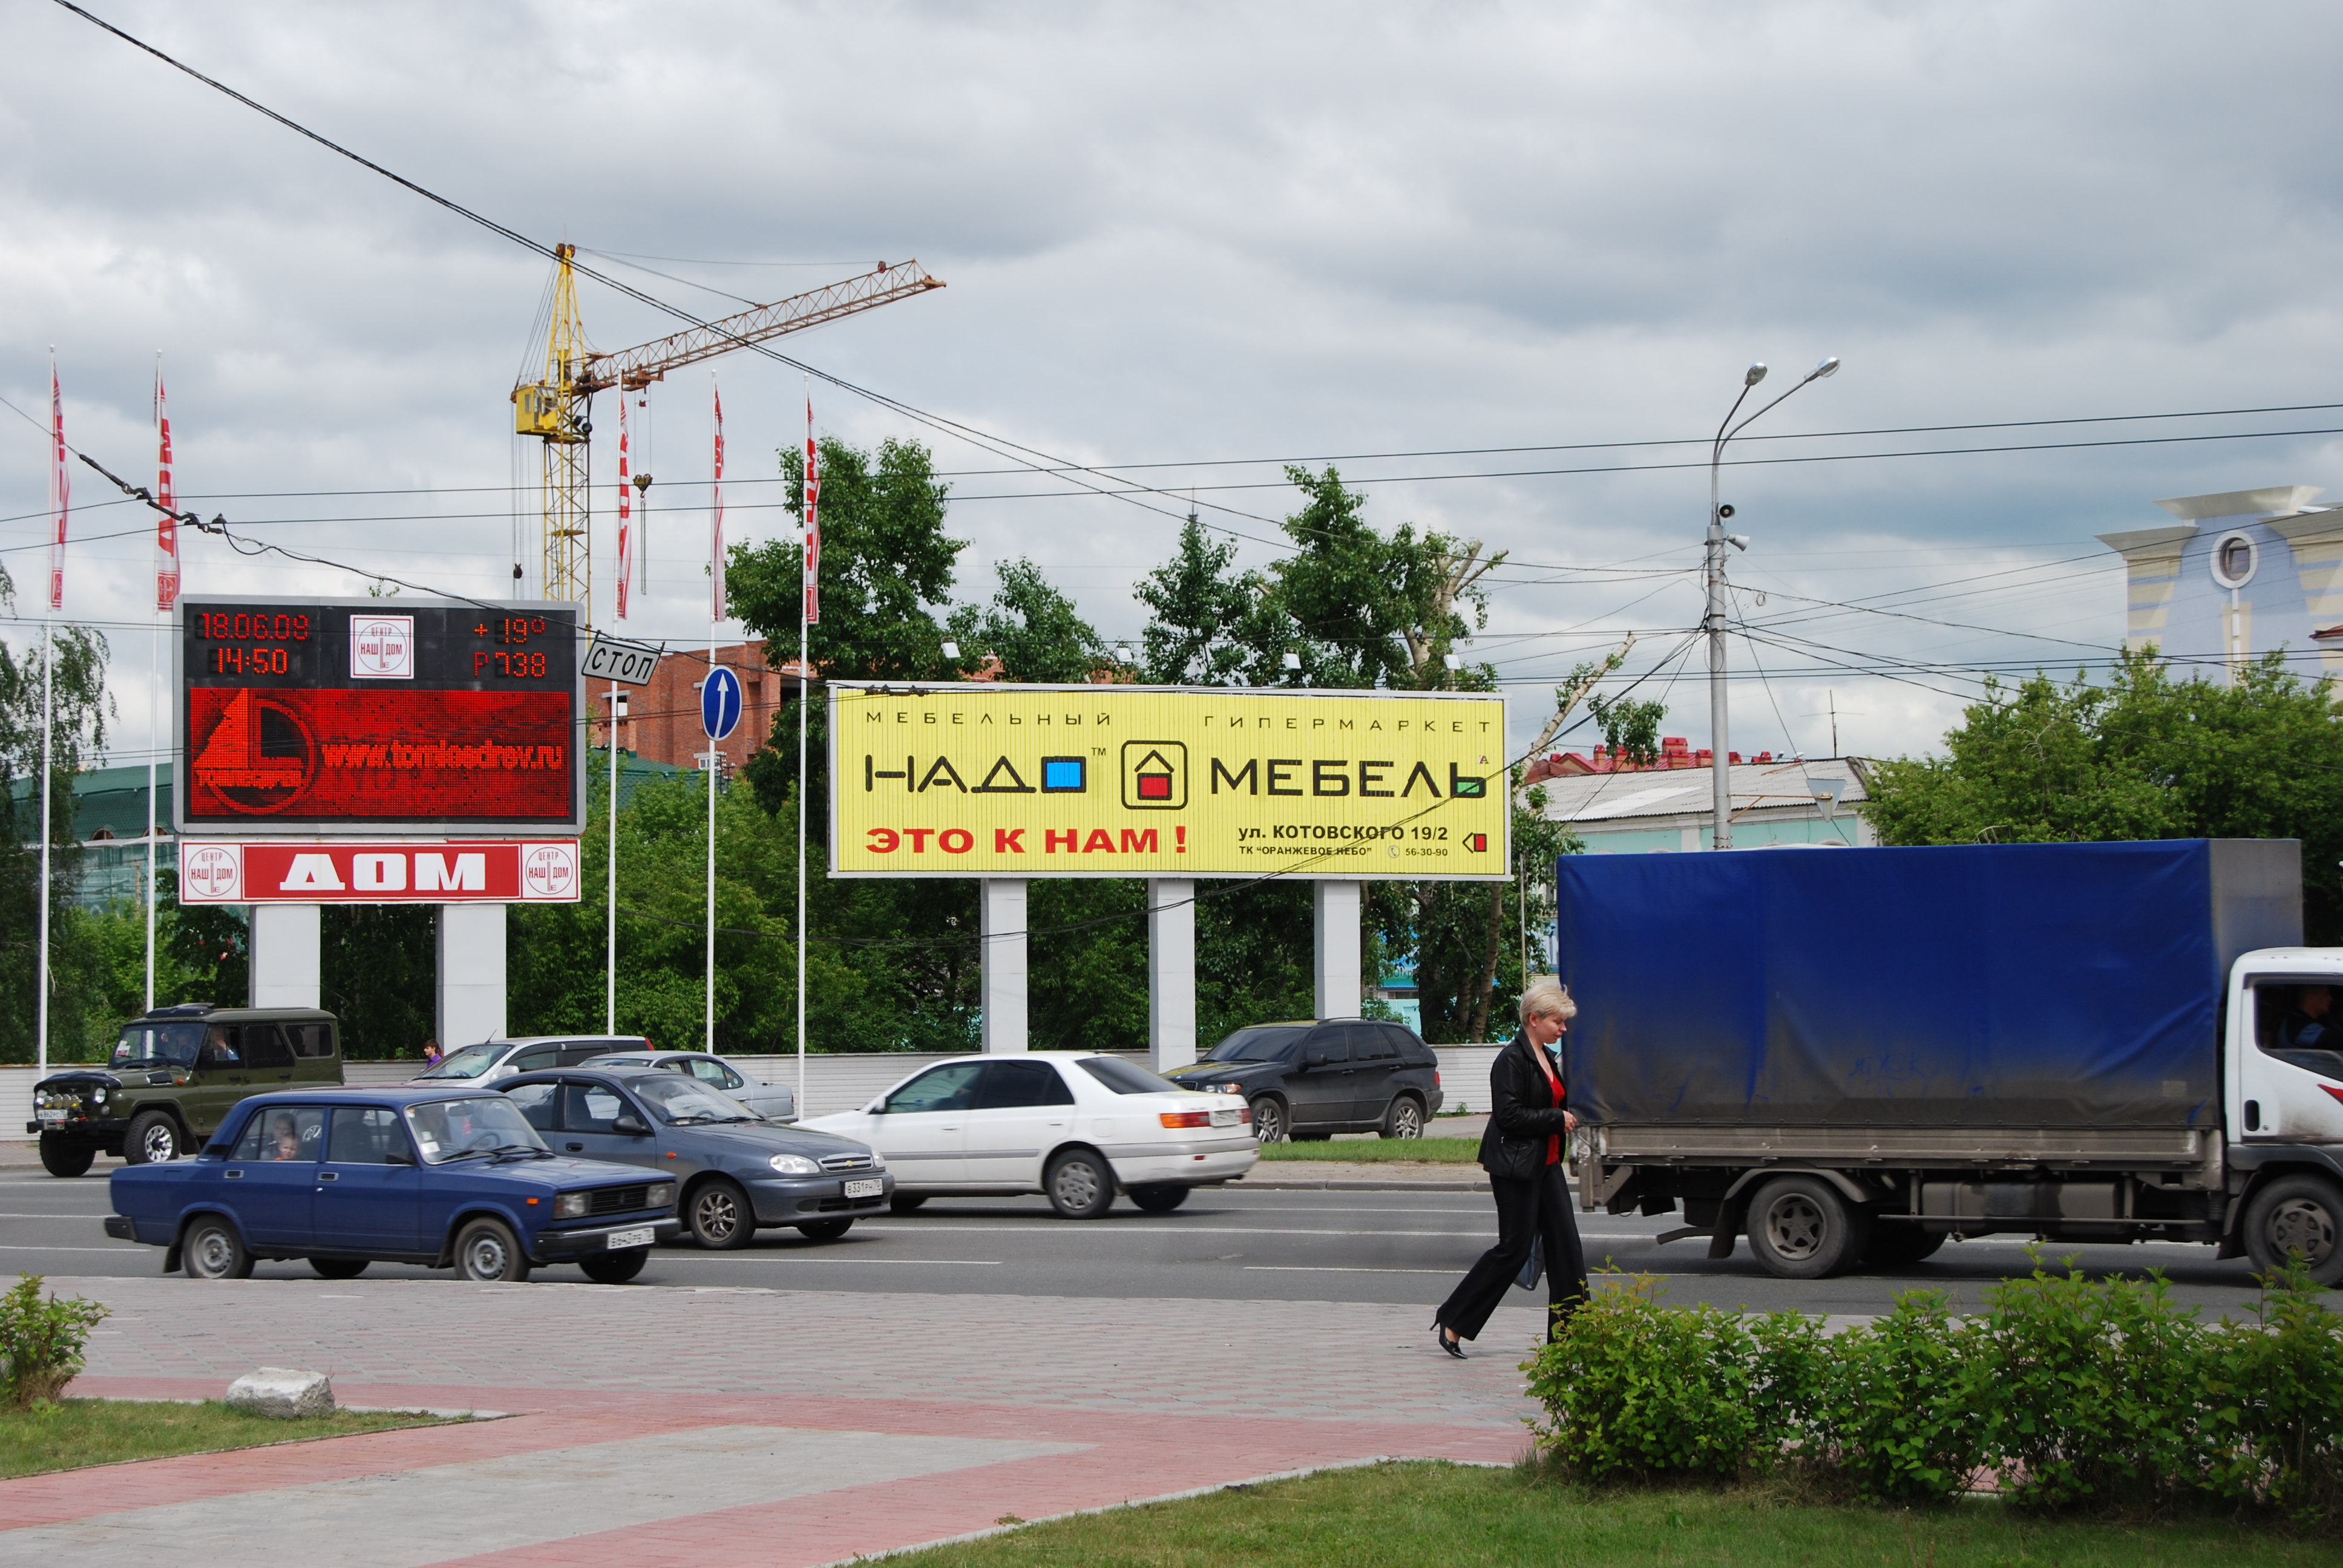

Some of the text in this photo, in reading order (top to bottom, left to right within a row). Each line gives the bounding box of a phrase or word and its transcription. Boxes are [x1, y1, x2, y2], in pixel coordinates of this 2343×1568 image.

[361, 643, 402, 656] НАШ ДОМ
[218, 648, 287, 674] 14:50
[495, 652, 545, 677] 738
[591, 647, 654, 679] СТОП
[866, 711, 1110, 726] МЕБЕЛЬНЫЙ
[1205, 716, 1490, 733] ГИПЕРМАРКЕТ
[1211, 757, 1487, 799] МЕБЕЛЬ
[1238, 825, 1448, 841] ул. КОТОВСКОГО 19/2
[865, 828, 974, 854] ЭТО
[995, 828, 1026, 854] К
[202, 852, 222, 862] ЦЕНТР
[539, 852, 559, 861] ЦЕНТР
[1239, 846, 1253, 855] ТК
[1405, 848, 1448, 857] 56-30-90
[191, 868, 233, 880] НАШ ДОМ
[280, 854, 485, 891] ДОМ
[529, 867, 568, 879] НАШ ДОМ
